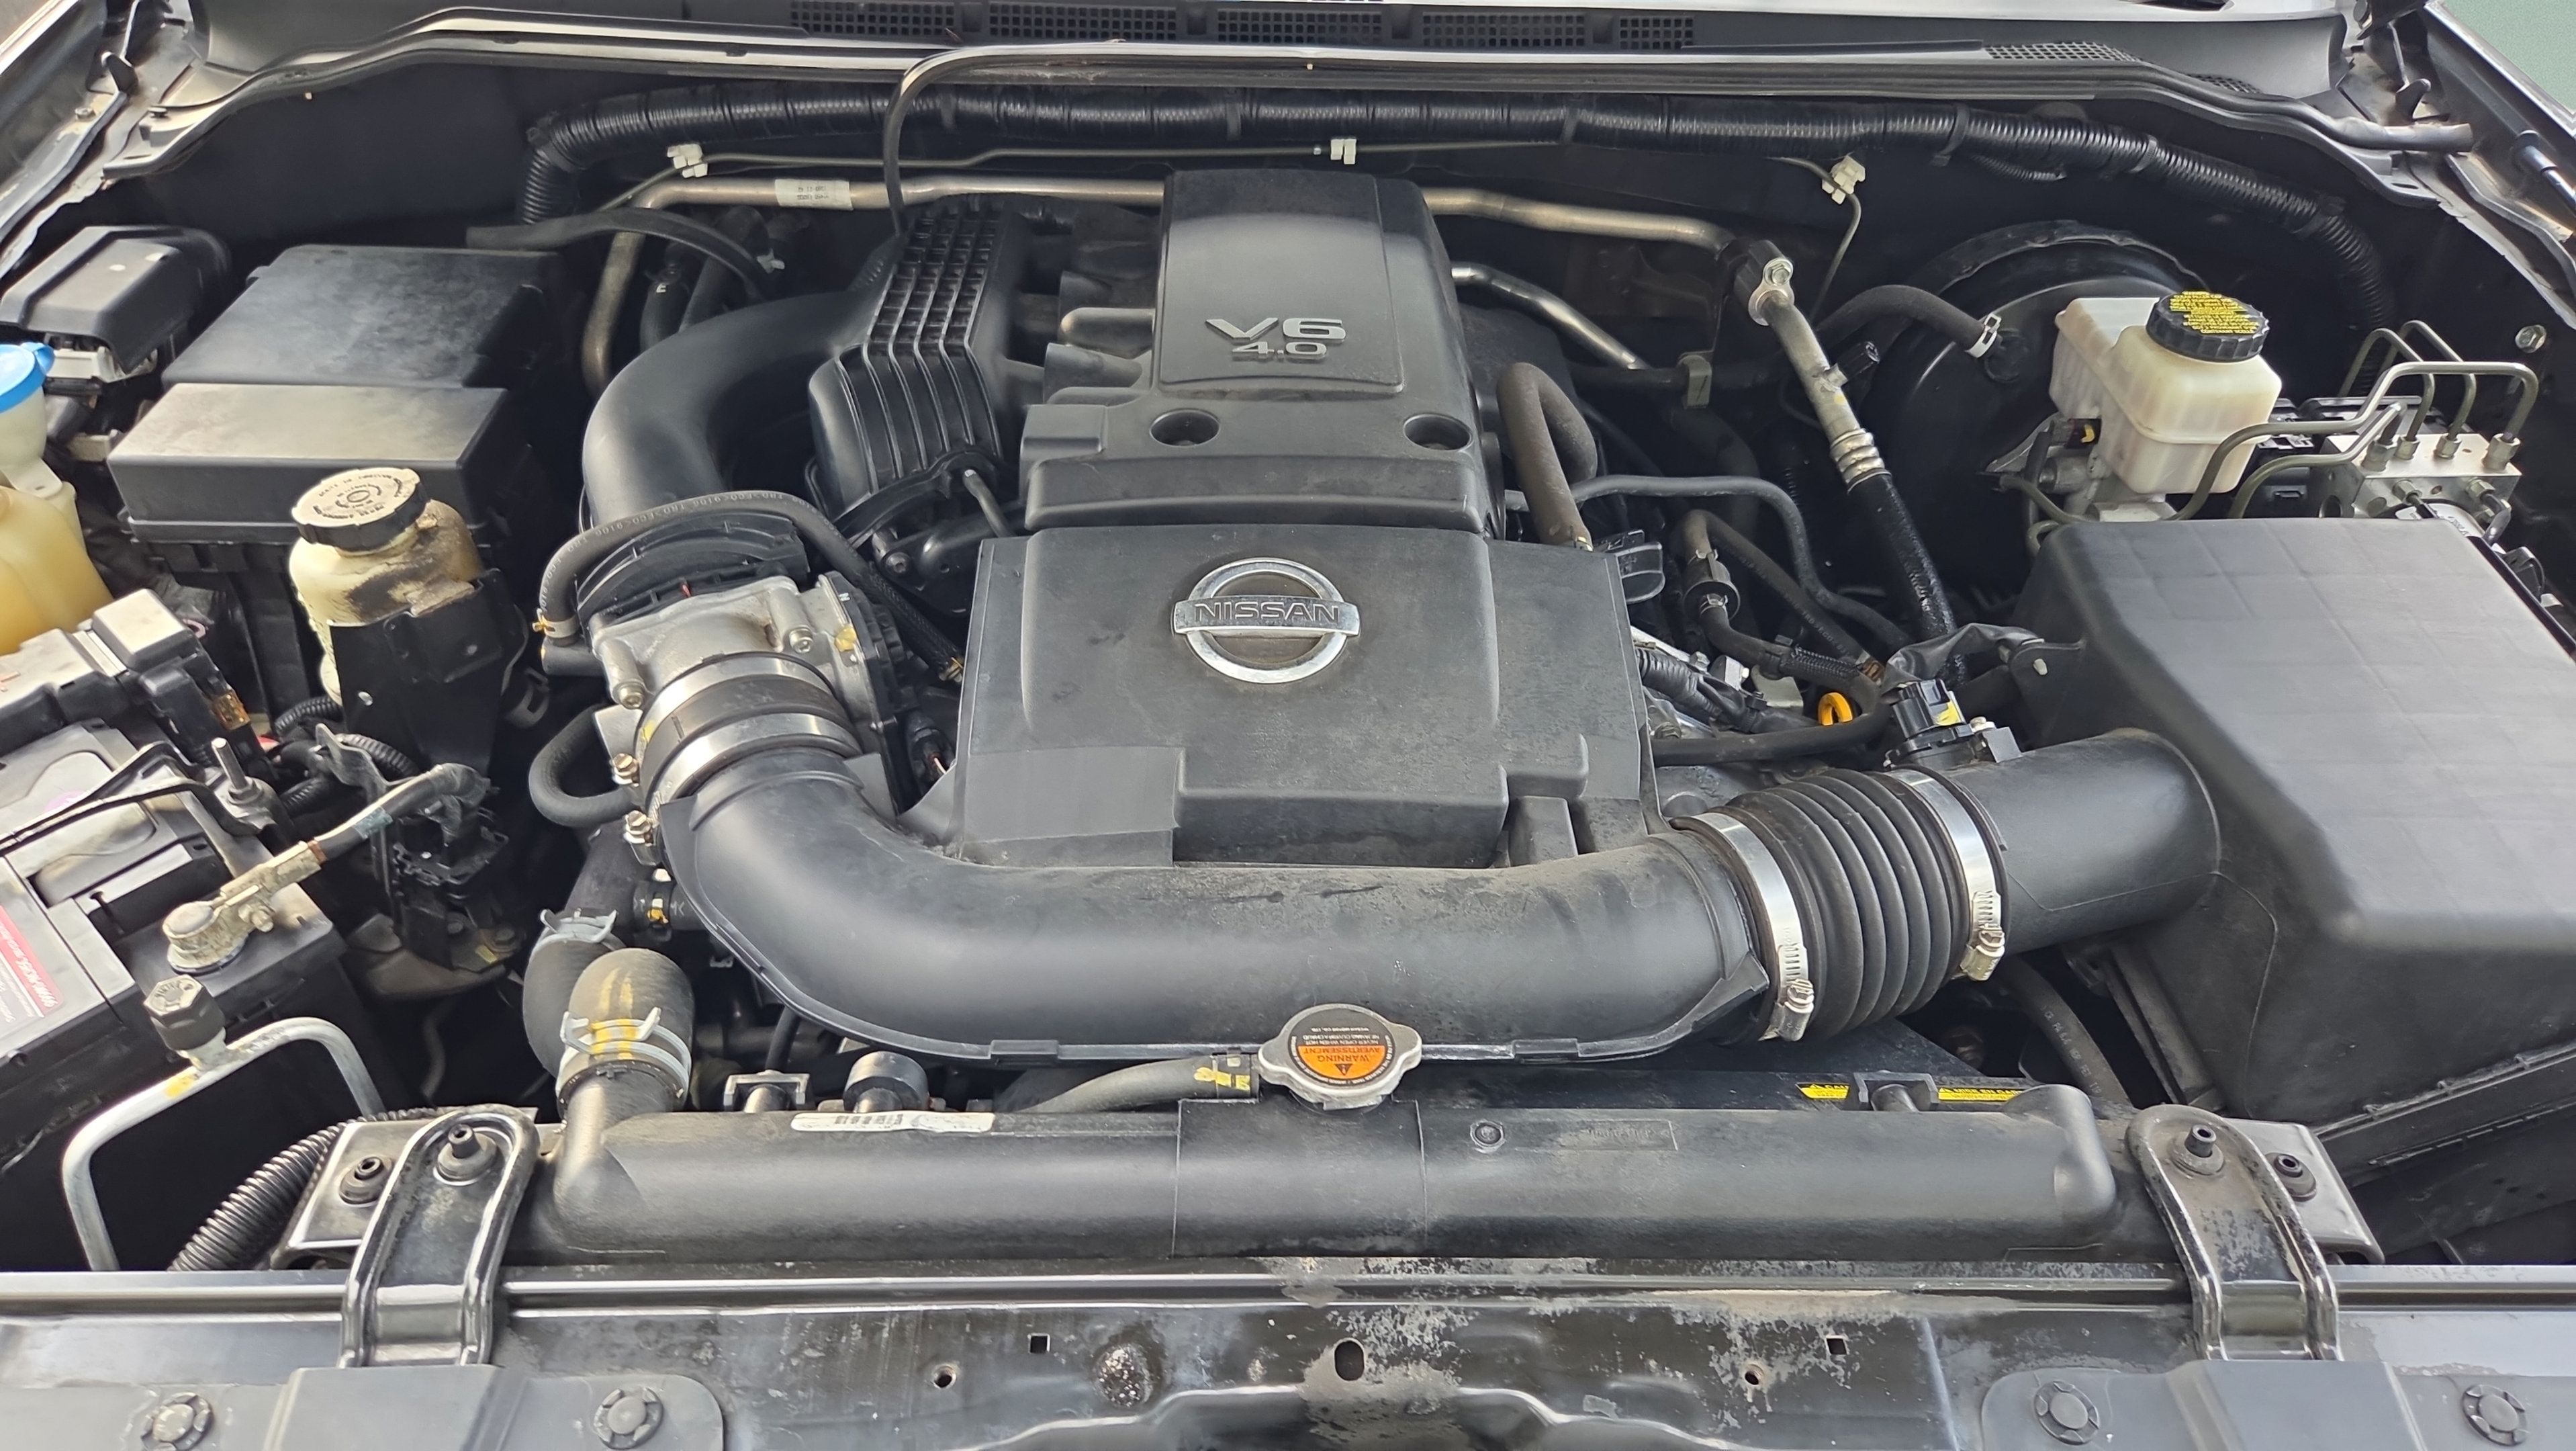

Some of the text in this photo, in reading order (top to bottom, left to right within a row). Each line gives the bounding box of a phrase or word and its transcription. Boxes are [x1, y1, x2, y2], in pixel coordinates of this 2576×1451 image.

[1205, 317, 1346, 340] V6
[1232, 341, 1327, 357] 4.0
[1194, 601, 1339, 623] NISSAN
